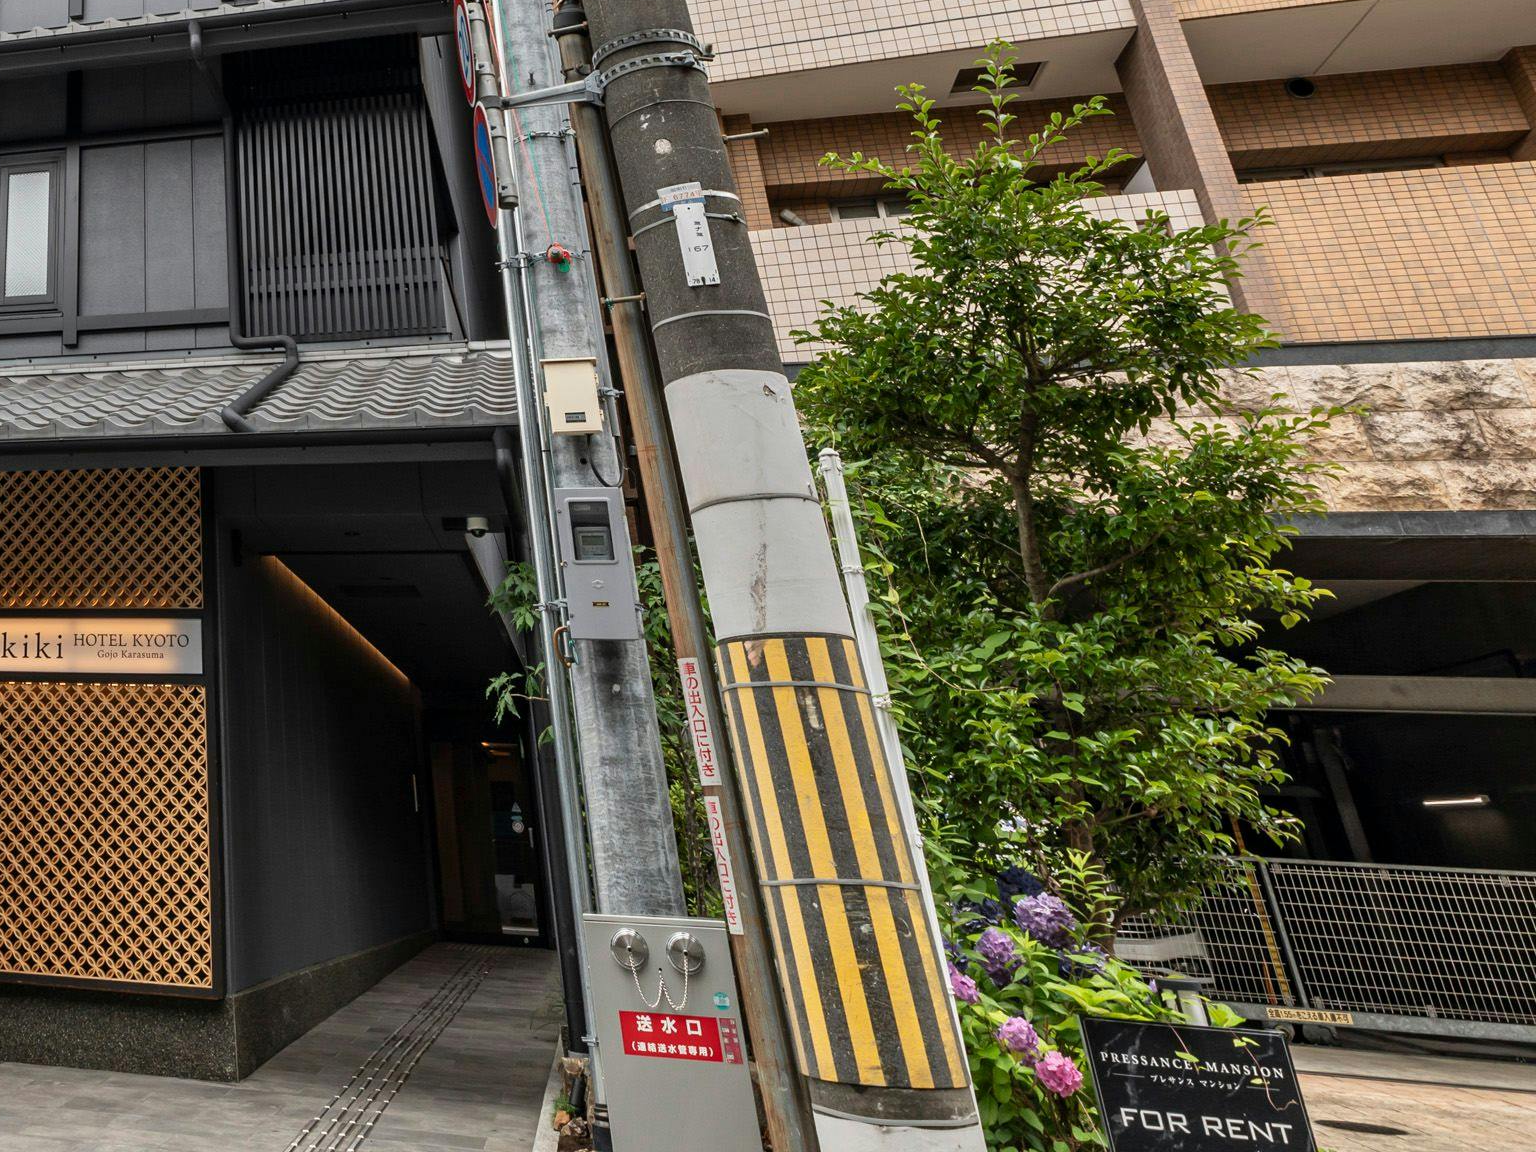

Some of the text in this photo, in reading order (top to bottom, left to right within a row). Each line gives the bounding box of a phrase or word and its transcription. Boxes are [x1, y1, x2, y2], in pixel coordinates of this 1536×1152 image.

[1, 632, 190, 659] kiki HOTEL KYOTO
[97, 649, 164, 660] Gojo Karasuma
[682, 662, 715, 777] 車の出入口に付き
[636, 1015, 702, 1036] 送水口
[1100, 1051, 1285, 1079] PRESSANCE MANSION
[1150, 1074, 1241, 1091] プレサンス マンション
[1120, 1107, 1293, 1145] FOR RENT
